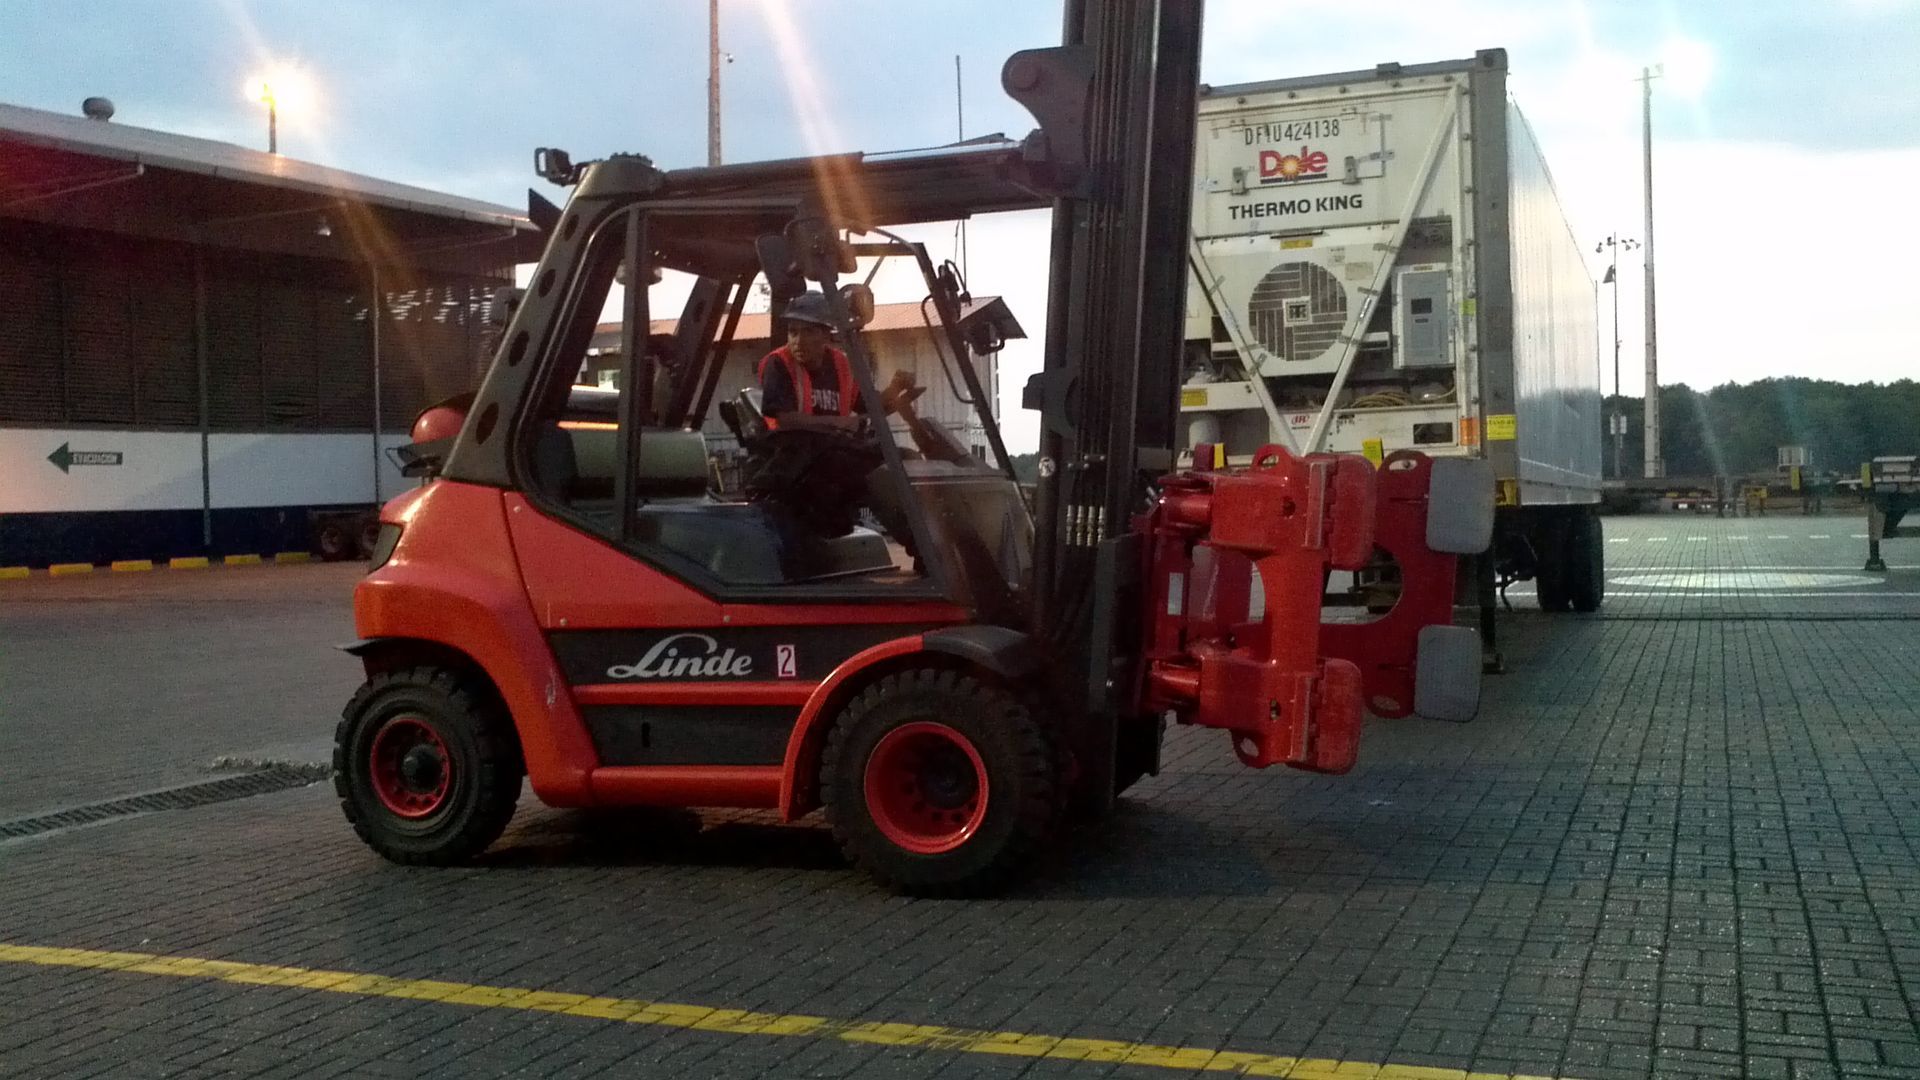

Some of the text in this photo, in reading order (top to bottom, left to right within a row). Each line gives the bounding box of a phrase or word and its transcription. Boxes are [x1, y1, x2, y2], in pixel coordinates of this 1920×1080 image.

[1259, 145, 1329, 178] Dole
[1228, 194, 1363, 220] THERMO KING
[606, 632, 794, 679] Linde 2
